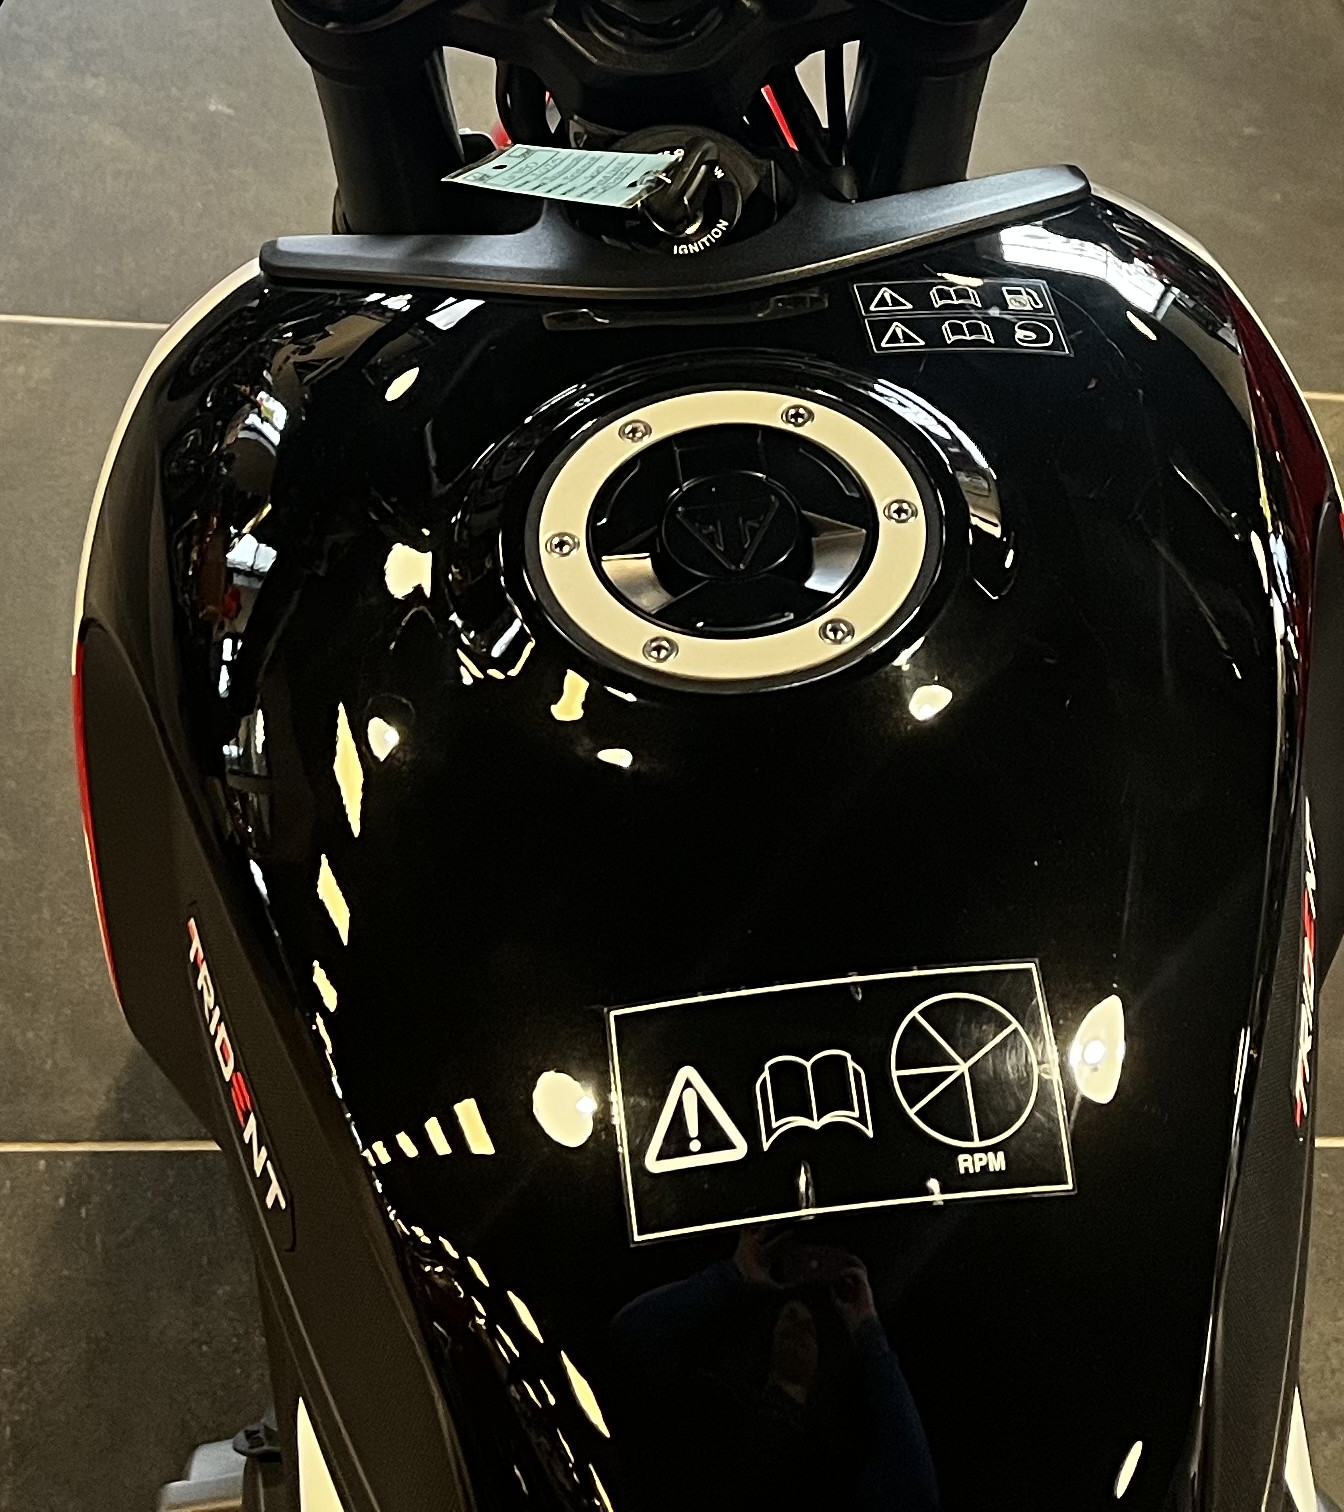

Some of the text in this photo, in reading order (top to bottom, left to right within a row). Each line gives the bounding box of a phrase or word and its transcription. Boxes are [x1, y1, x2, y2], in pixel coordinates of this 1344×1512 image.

[673, 219, 730, 255] IGNITION
[187, 917, 287, 1210] TRIDENT
[957, 1150, 1006, 1175] RPM
